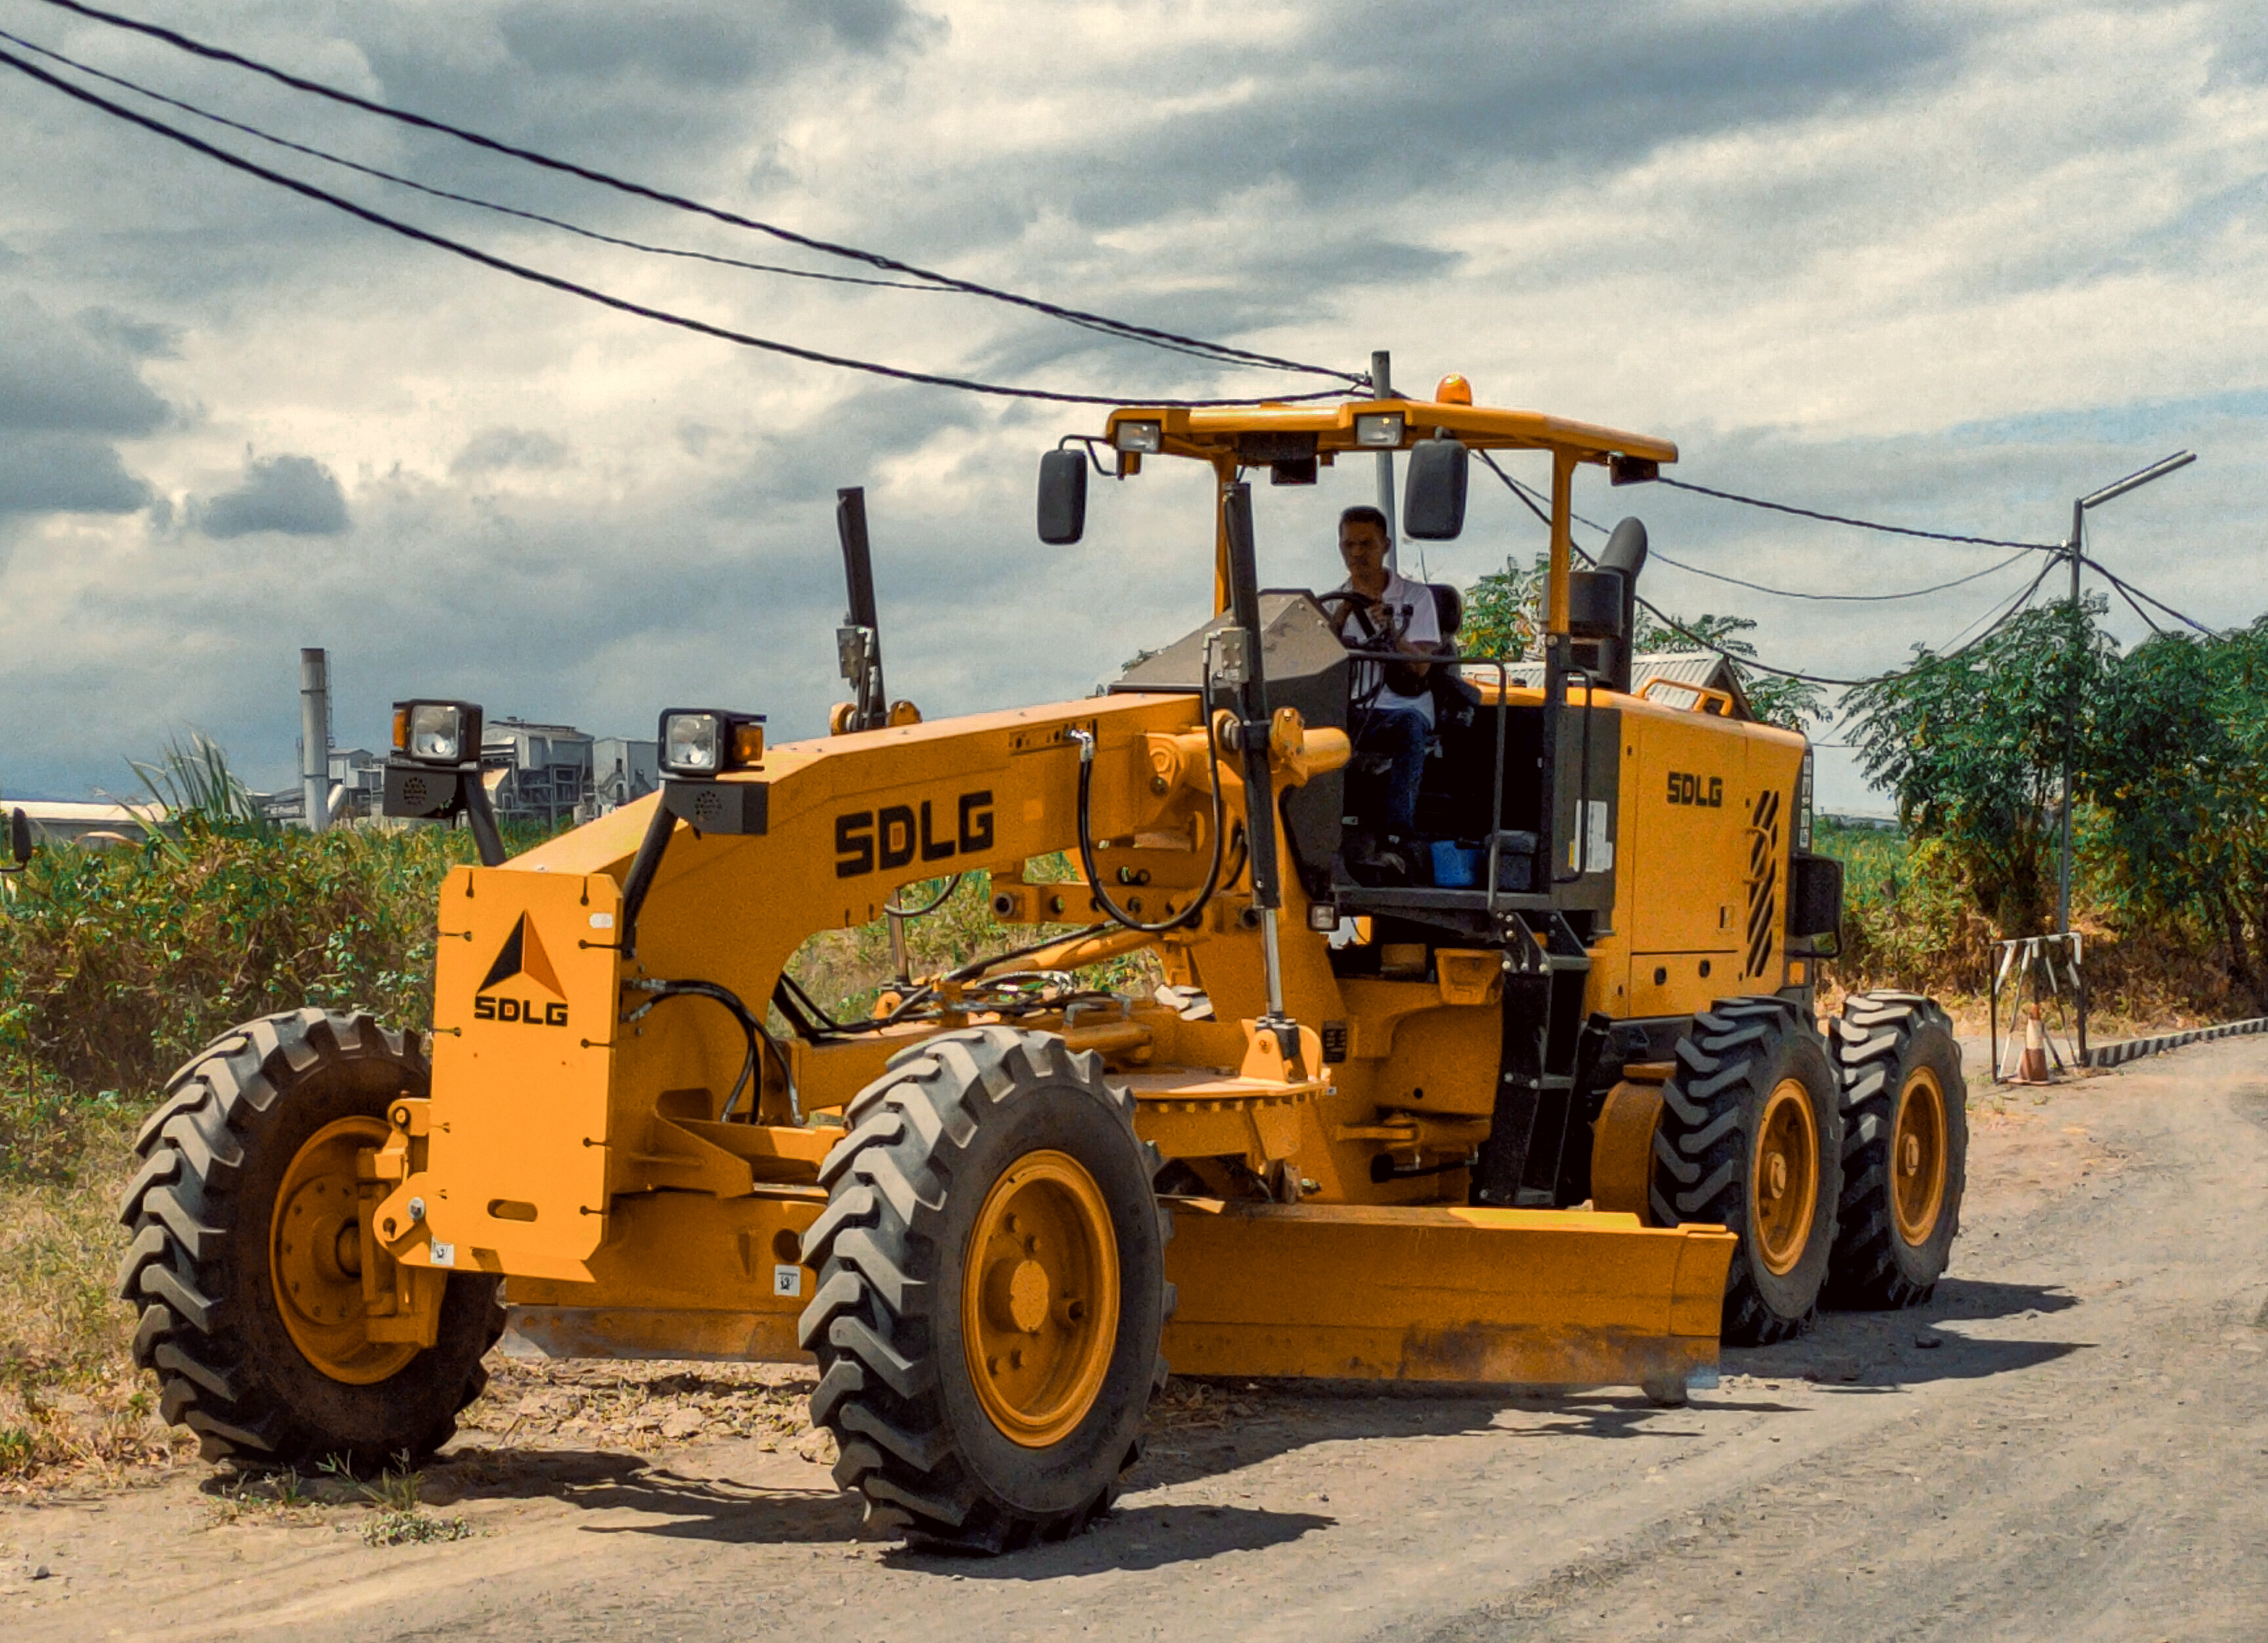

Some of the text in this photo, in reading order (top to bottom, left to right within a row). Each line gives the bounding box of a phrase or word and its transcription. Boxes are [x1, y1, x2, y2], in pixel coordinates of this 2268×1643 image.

[1667, 771, 1723, 808] SDLG
[835, 790, 994, 879] SDLG
[474, 996, 569, 1027] SDLG
